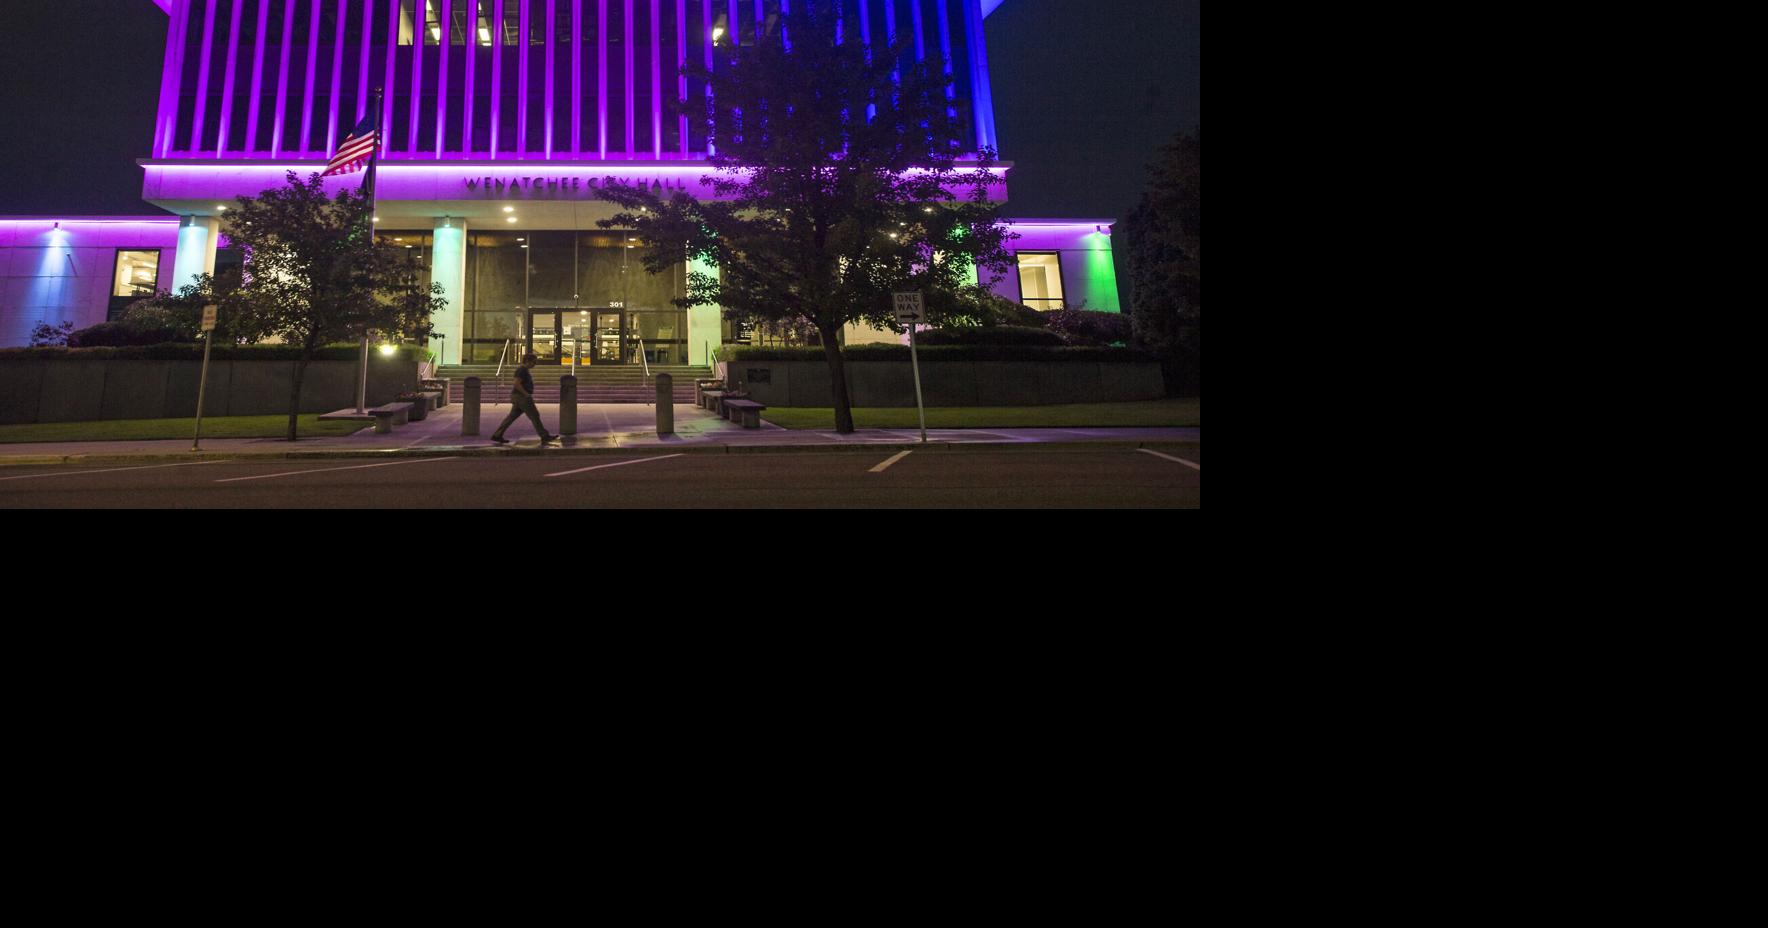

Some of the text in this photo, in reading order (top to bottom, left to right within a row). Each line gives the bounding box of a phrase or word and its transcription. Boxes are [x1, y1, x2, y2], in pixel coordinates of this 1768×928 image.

[464, 176, 686, 191] WENATCHEE CIY HALL
[897, 294, 920, 303] ONE
[897, 303, 920, 311] WAY
